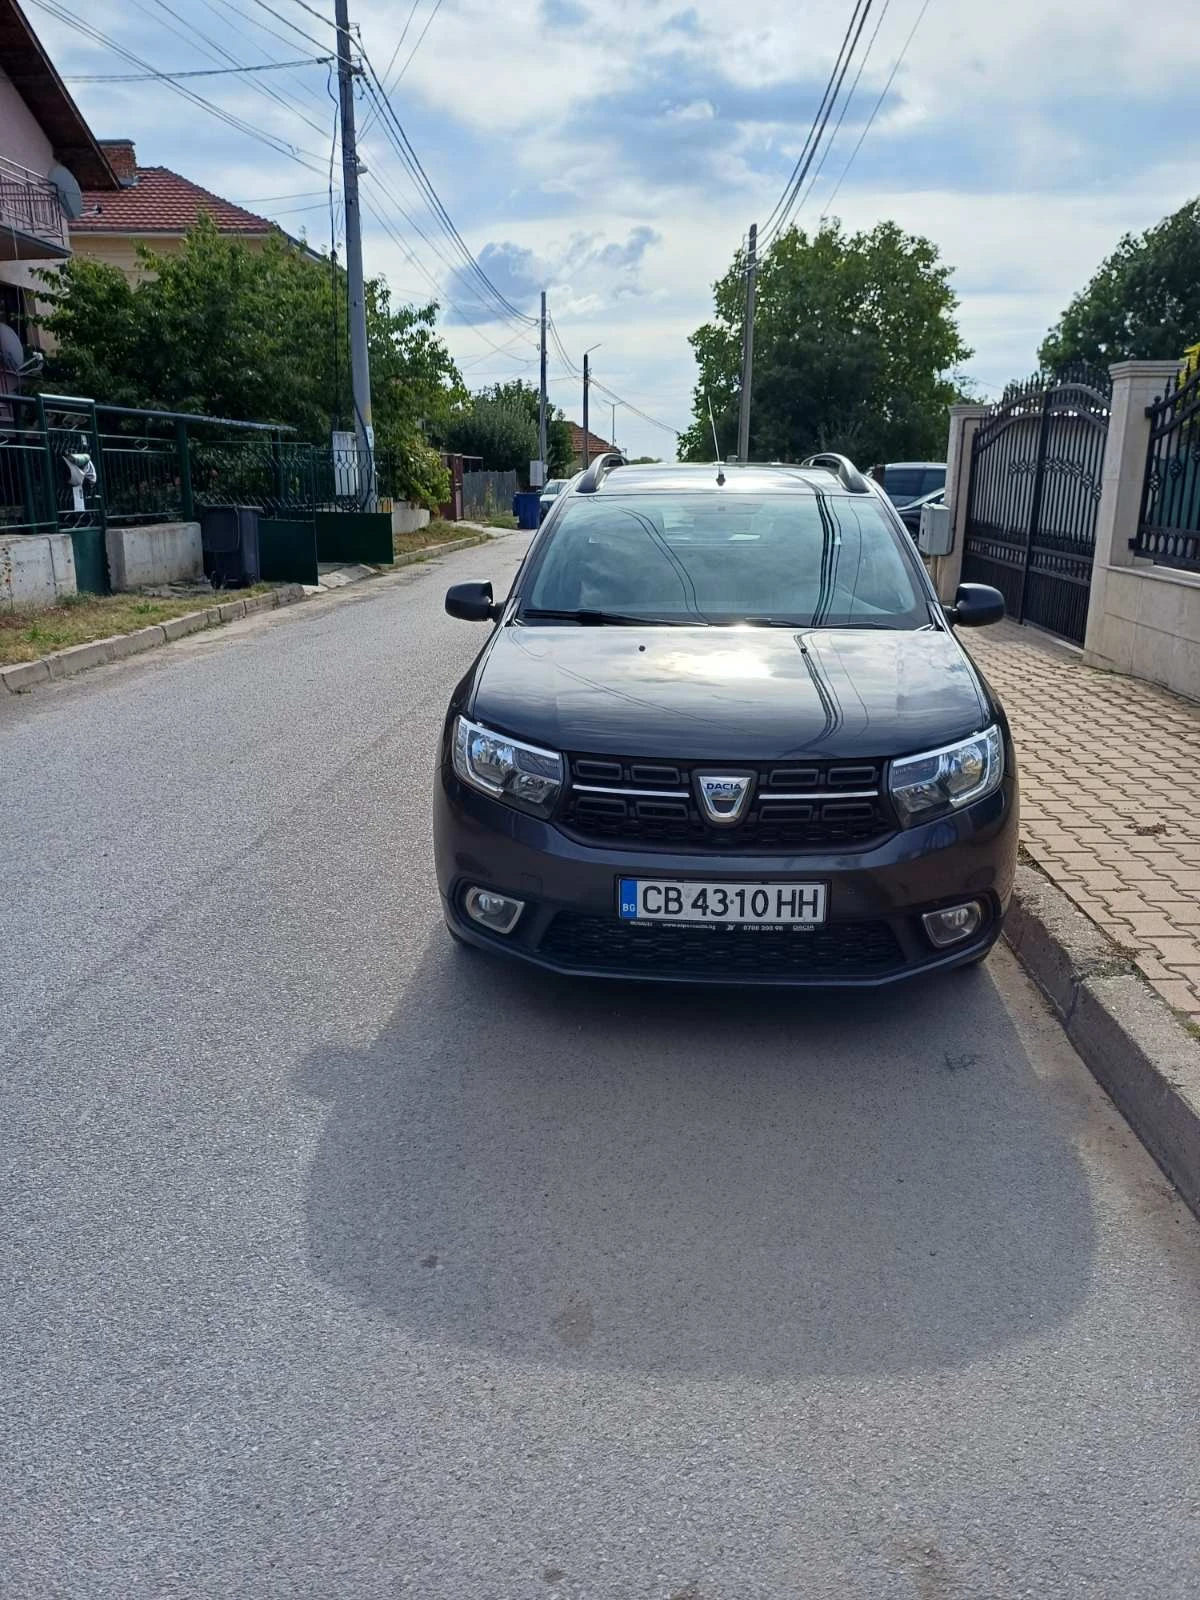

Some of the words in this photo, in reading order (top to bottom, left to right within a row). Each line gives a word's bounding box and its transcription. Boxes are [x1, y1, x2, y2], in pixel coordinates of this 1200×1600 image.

[622, 903, 636, 912] BG
[642, 885, 683, 915] CB
[690, 887, 769, 918] 4310
[776, 888, 819, 918] HH
